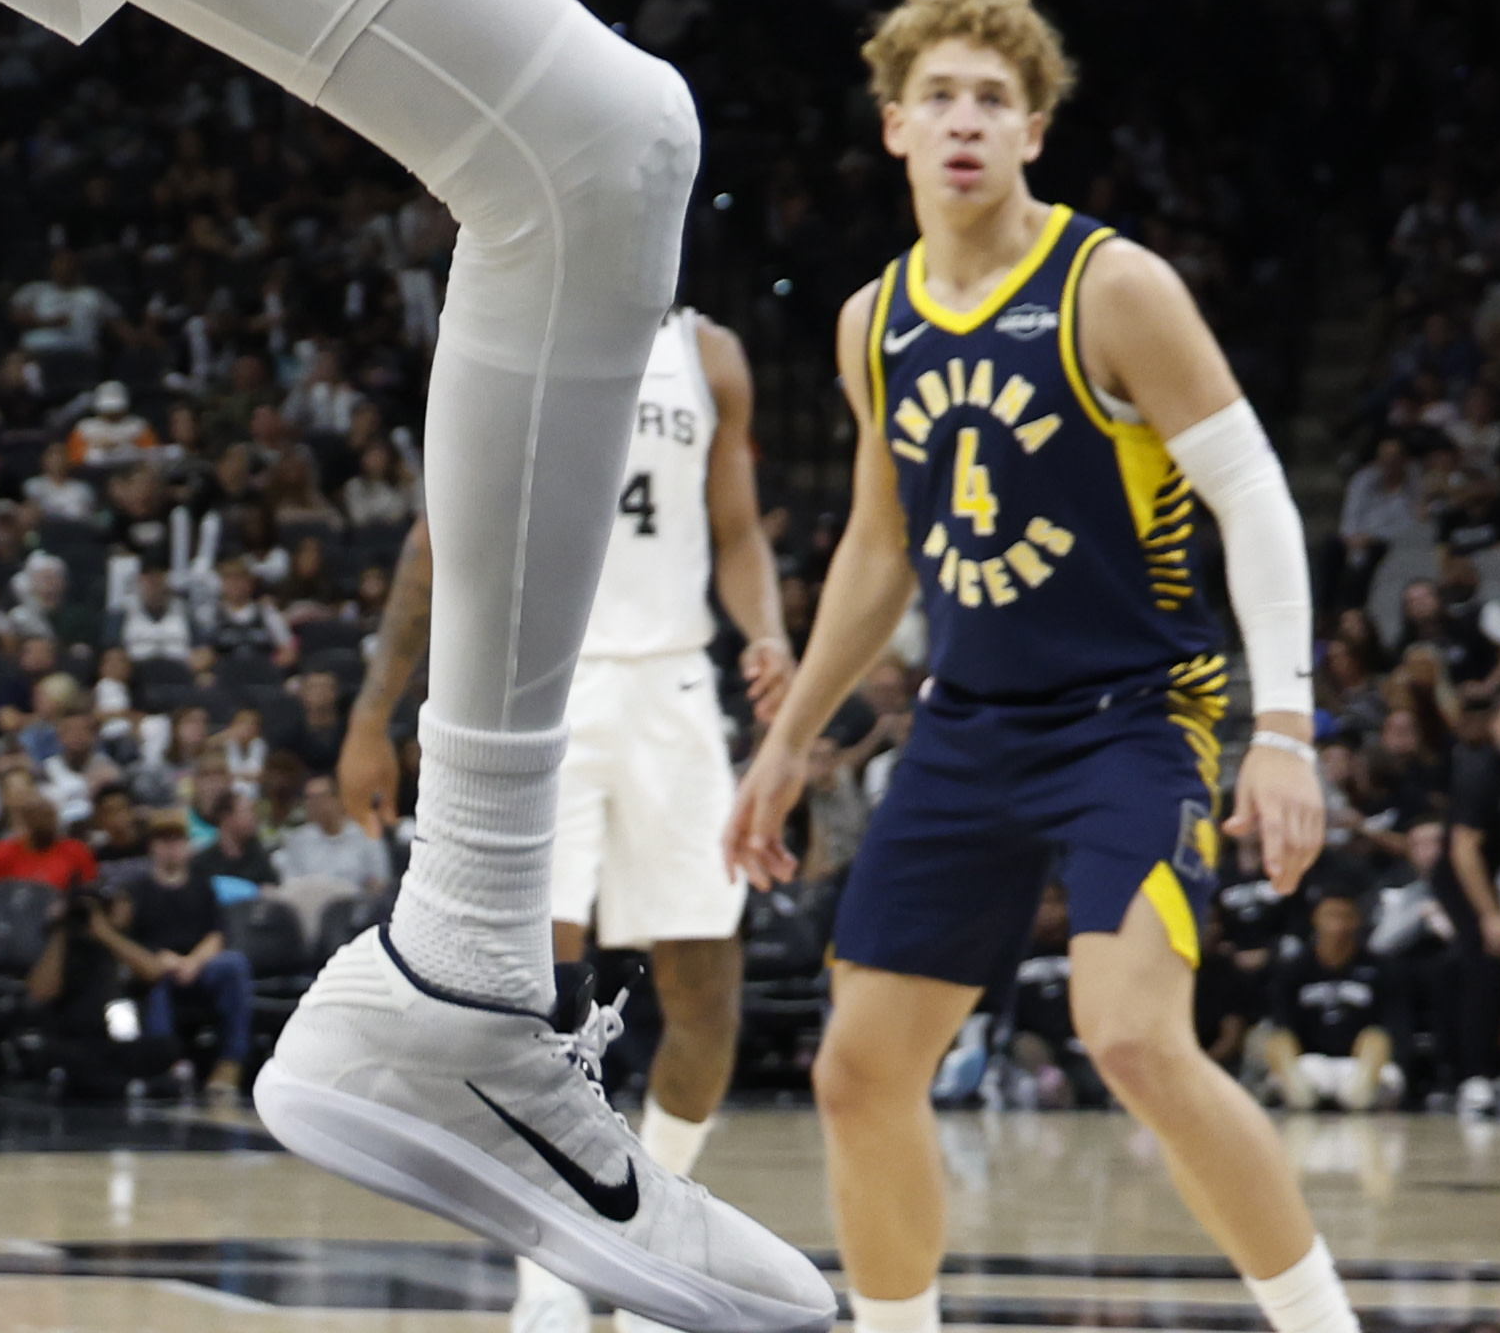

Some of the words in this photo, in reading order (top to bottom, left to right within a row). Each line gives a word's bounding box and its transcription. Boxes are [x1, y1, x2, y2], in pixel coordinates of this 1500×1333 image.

[890, 356, 1063, 464] INDIANA
[620, 473, 656, 536] 4
[951, 427, 1000, 536] 4
[922, 516, 1076, 608] PACERS
